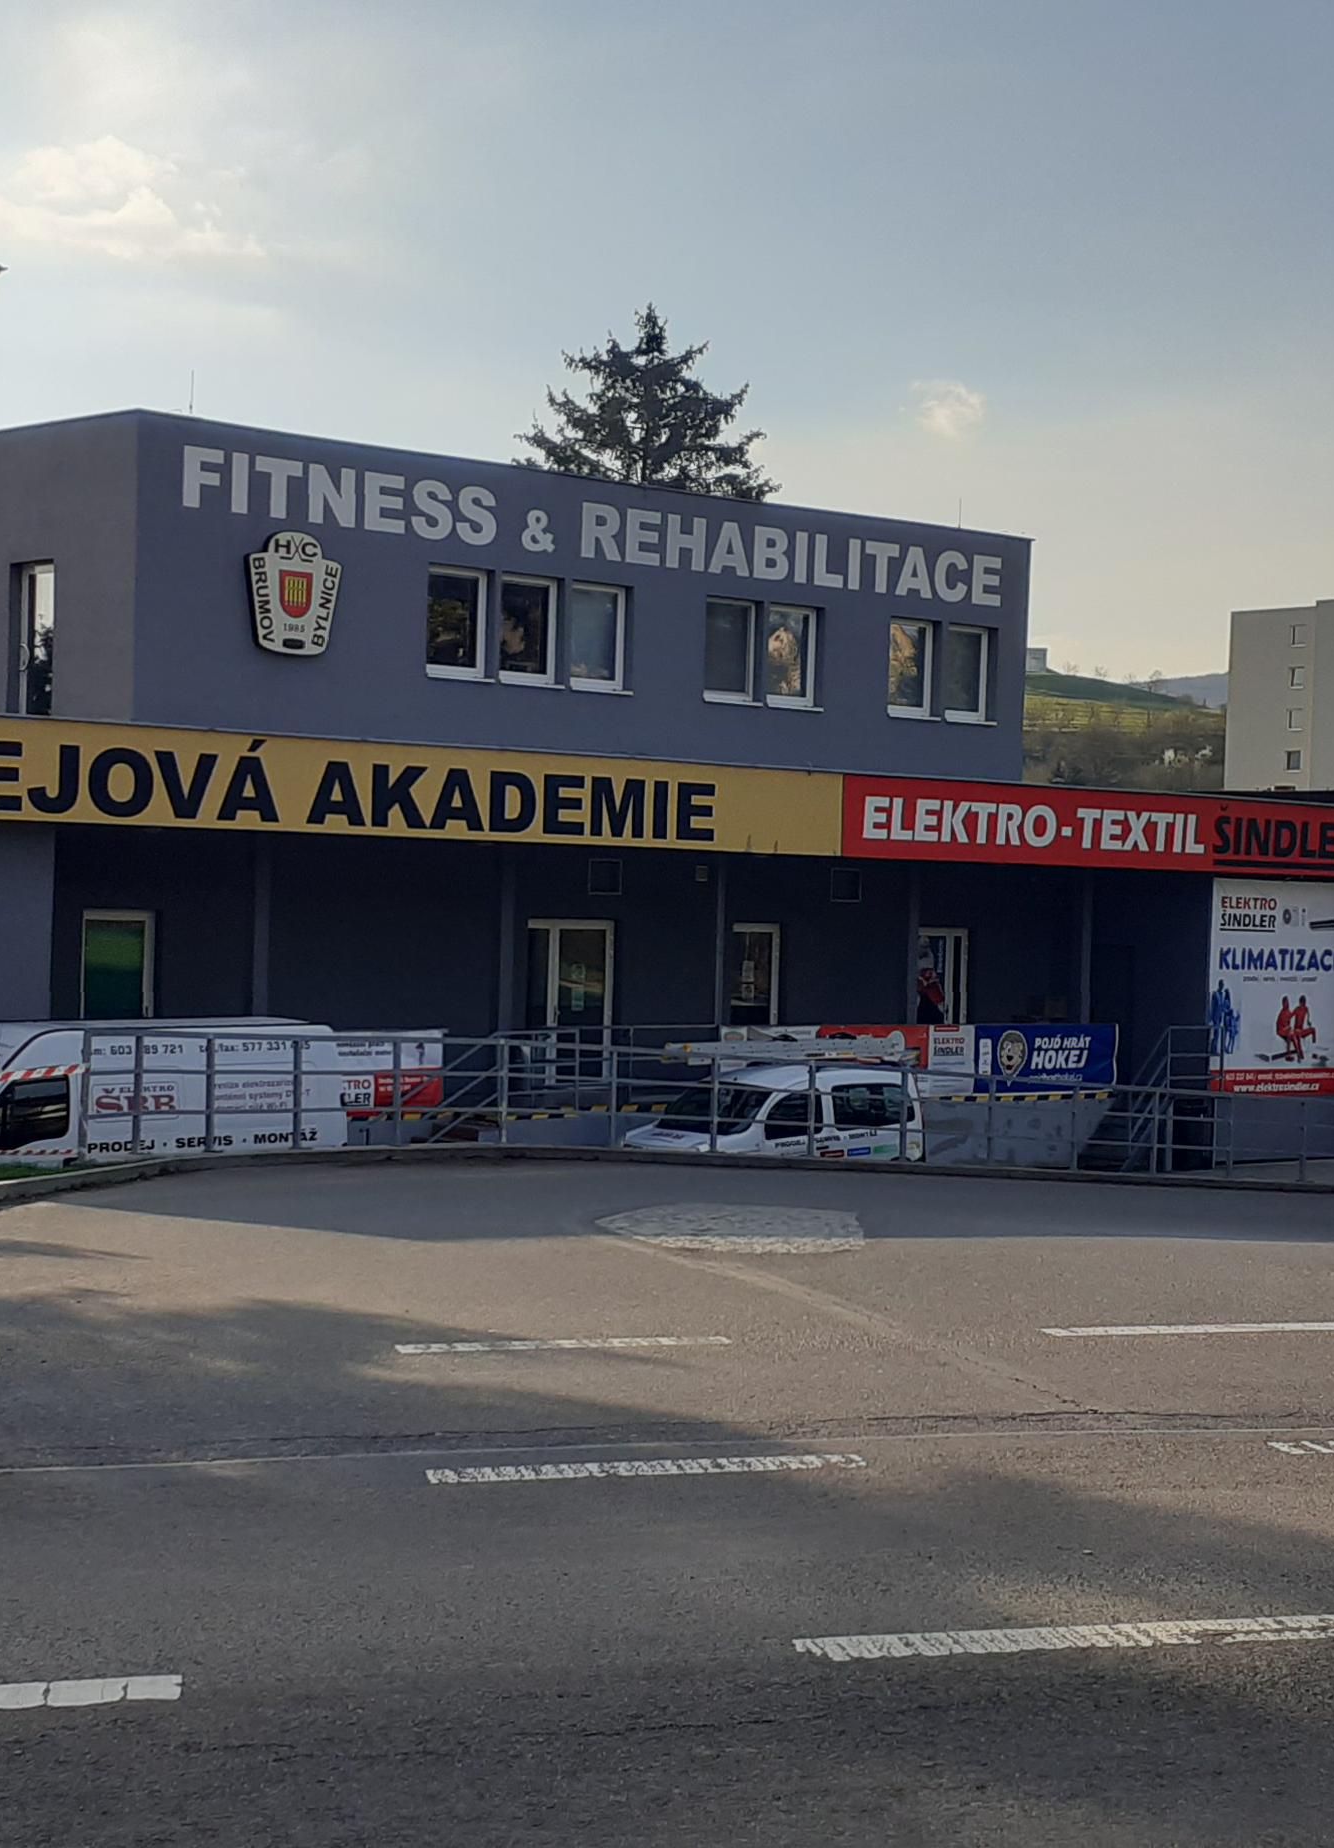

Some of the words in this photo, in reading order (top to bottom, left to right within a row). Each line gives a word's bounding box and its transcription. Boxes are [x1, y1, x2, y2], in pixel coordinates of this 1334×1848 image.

[182, 444, 497, 547] FITNESS
[521, 509, 556, 553] &
[581, 501, 1003, 607] REHABILITACE
[252, 557, 275, 643] BRUMOV
[311, 564, 338, 647] BYLNICE
[305, 760, 718, 843] AKADEMIE
[1221, 896, 1277, 911] ELEKTRO
[1220, 910, 1277, 928] ŠINDLER
[110, 1044, 133, 1055] 603
[163, 1044, 183, 1054] 721
[242, 1042, 263, 1052] 577
[267, 1041, 287, 1051] 331
[1062, 1034, 1092, 1049] HRÁT
[1030, 1049, 1089, 1070] HOKEJ
[118, 1084, 175, 1094] ELKTRO
[343, 1079, 371, 1090] TRO
